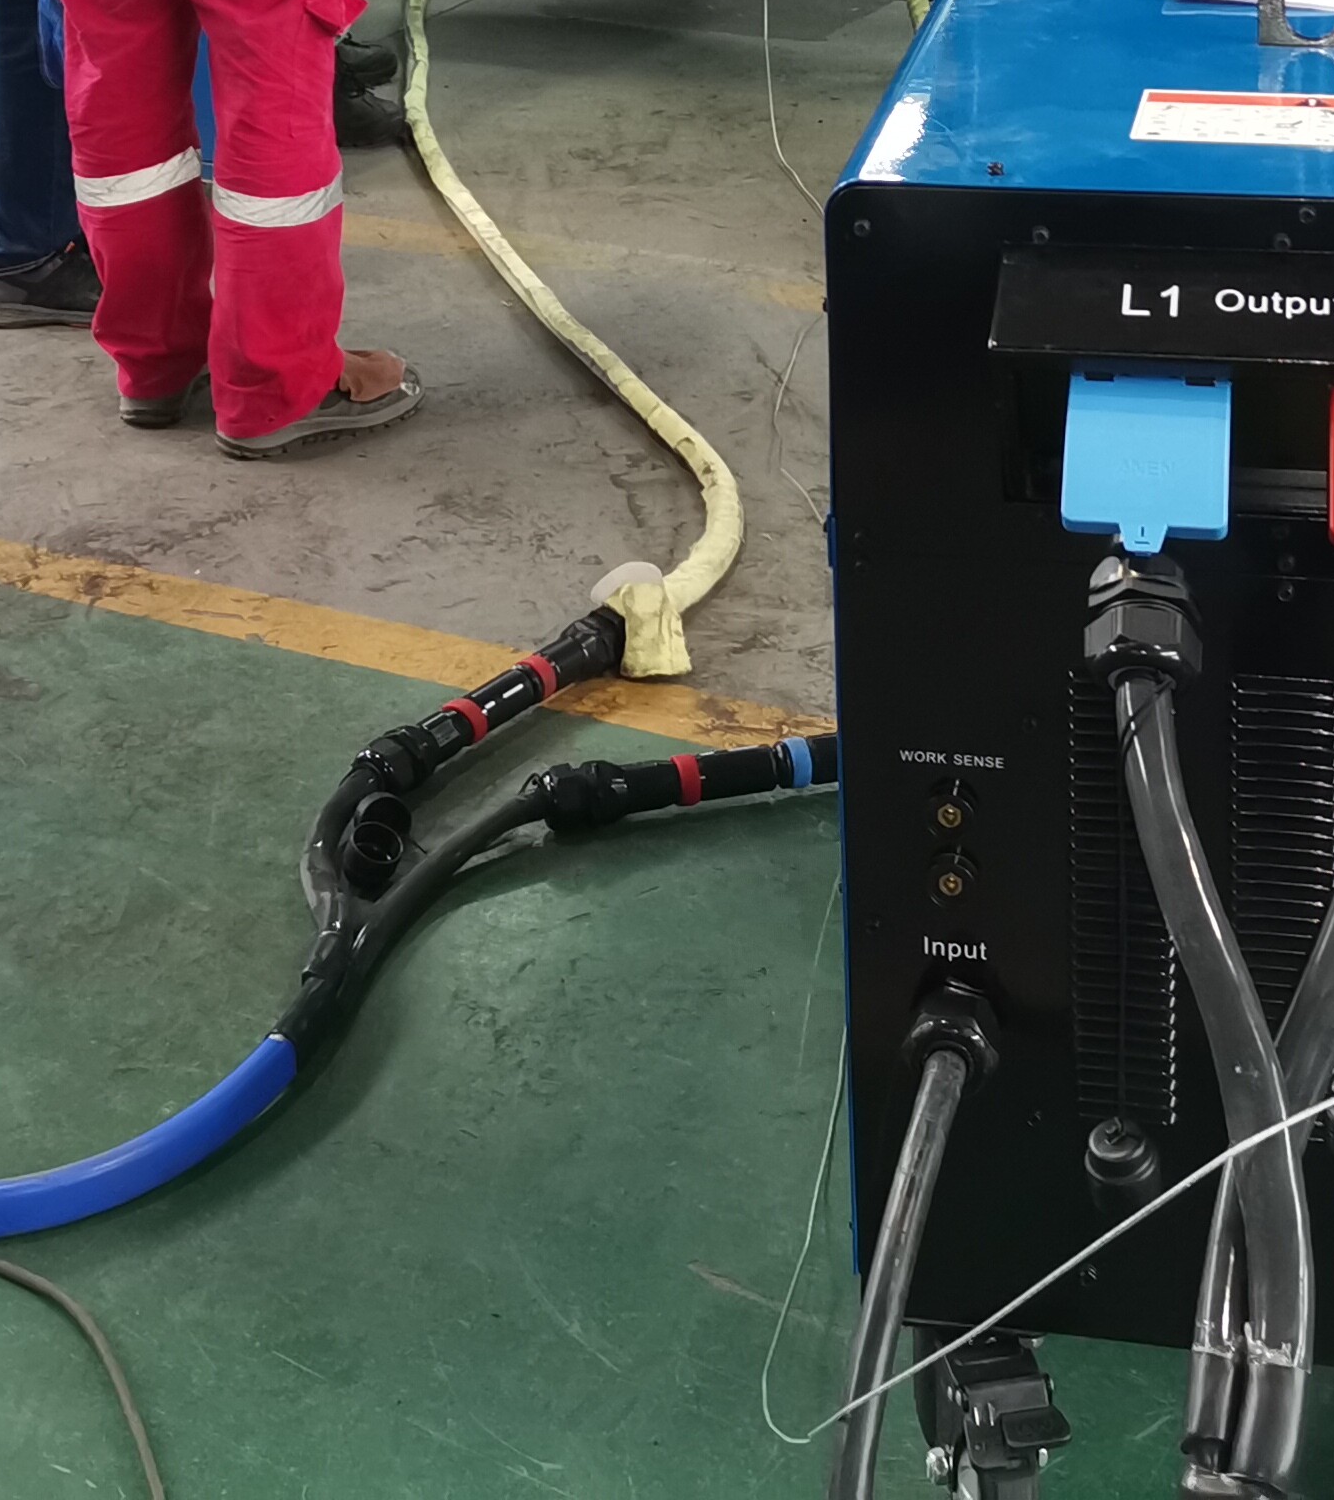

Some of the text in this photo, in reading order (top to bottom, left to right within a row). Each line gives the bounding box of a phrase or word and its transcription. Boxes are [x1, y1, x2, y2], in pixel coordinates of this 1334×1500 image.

[1120, 282, 1181, 318] L1
[899, 749, 1006, 770] WORK SENSE
[922, 935, 988, 962] Input
